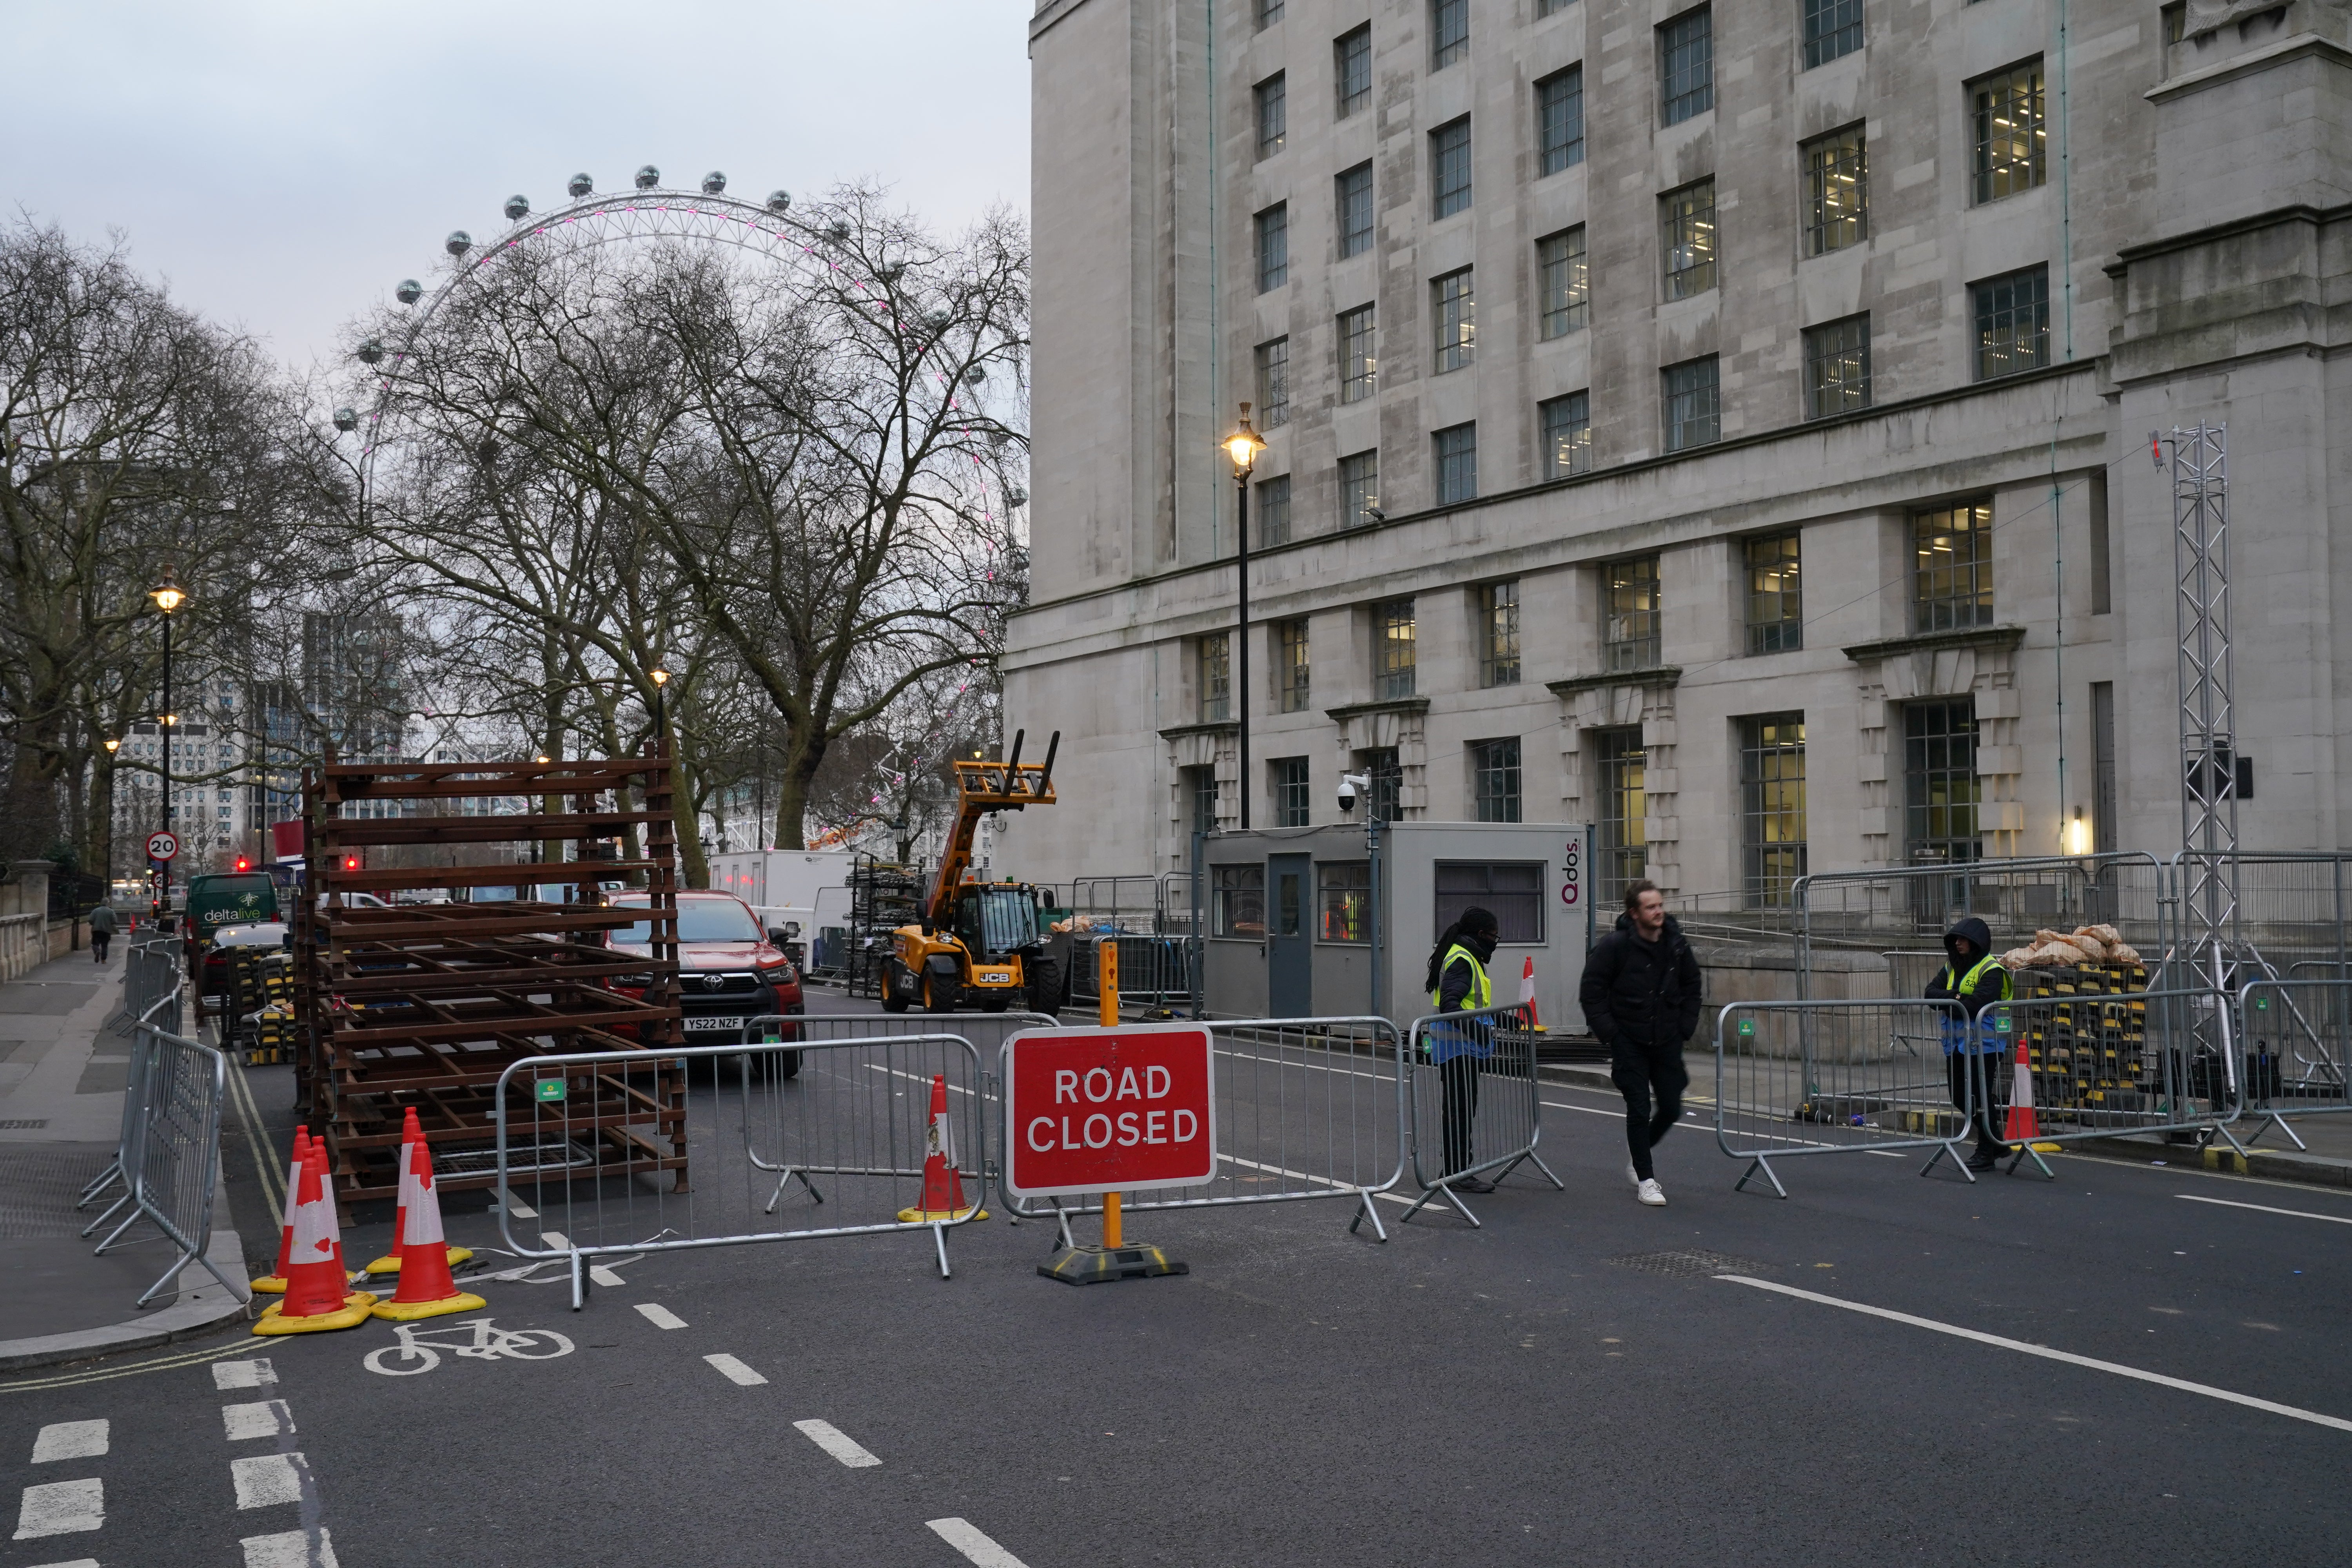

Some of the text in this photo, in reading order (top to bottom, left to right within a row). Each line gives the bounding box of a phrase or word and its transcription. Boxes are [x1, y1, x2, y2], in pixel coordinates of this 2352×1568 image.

[151, 840, 174, 852] 20
[205, 908, 260, 921] deltalive
[900, 975, 913, 989] JCB
[980, 973, 1009, 982] JCB
[689, 1018, 739, 1029] YS22 NZF
[1055, 1065, 1171, 1103] ROAD
[1027, 1109, 1198, 1152] CLOSED
